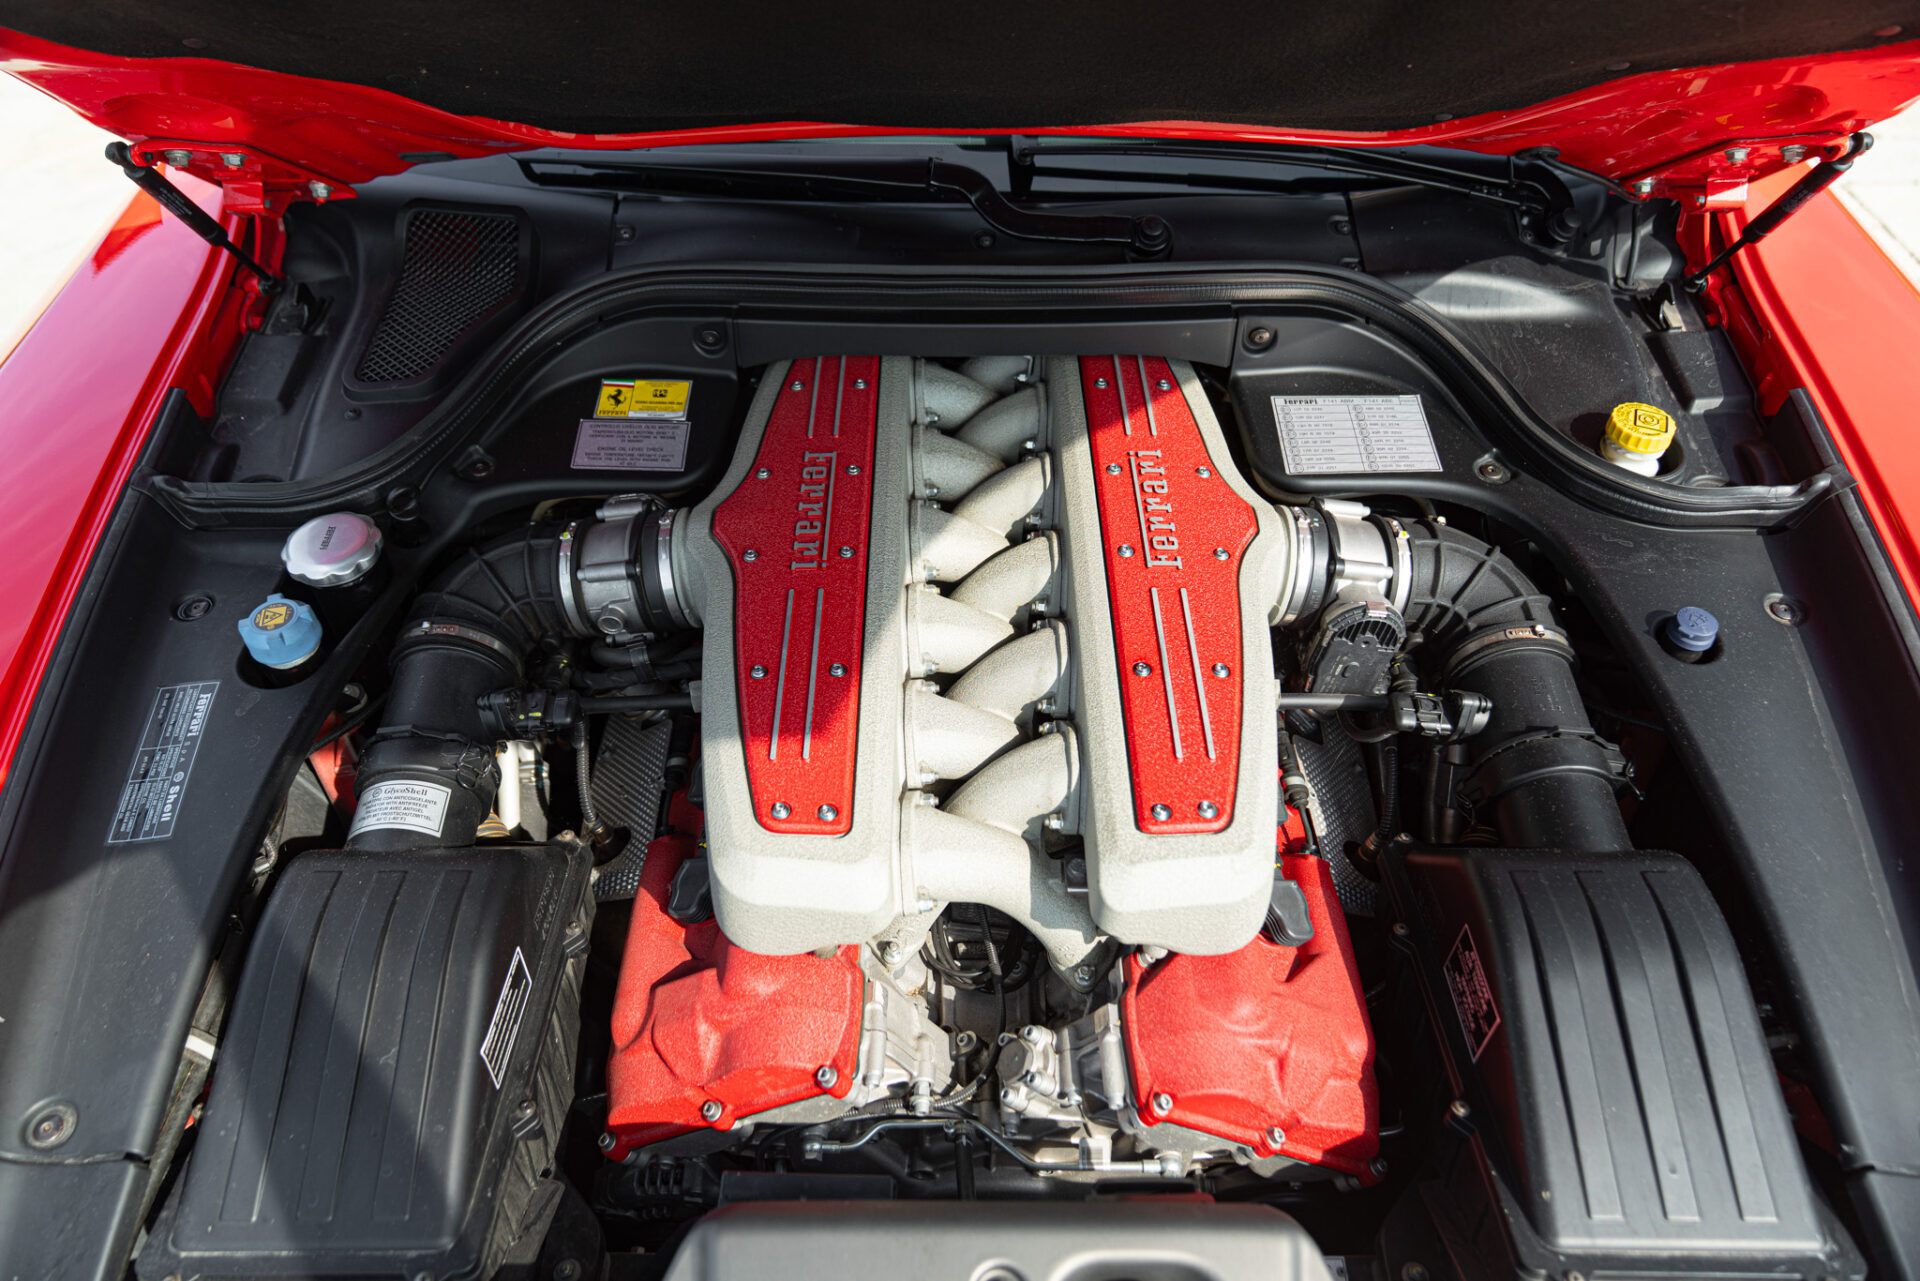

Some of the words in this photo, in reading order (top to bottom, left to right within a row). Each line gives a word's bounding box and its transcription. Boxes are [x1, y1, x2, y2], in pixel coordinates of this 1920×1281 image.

[790, 450, 838, 570] Ferrari
[1127, 450, 1183, 570] Ferrari
[319, 526, 336, 550] Ferrari
[185, 692, 212, 736] Ferrari
[159, 784, 181, 821] Shell
[384, 787, 428, 796] GlycoShell
